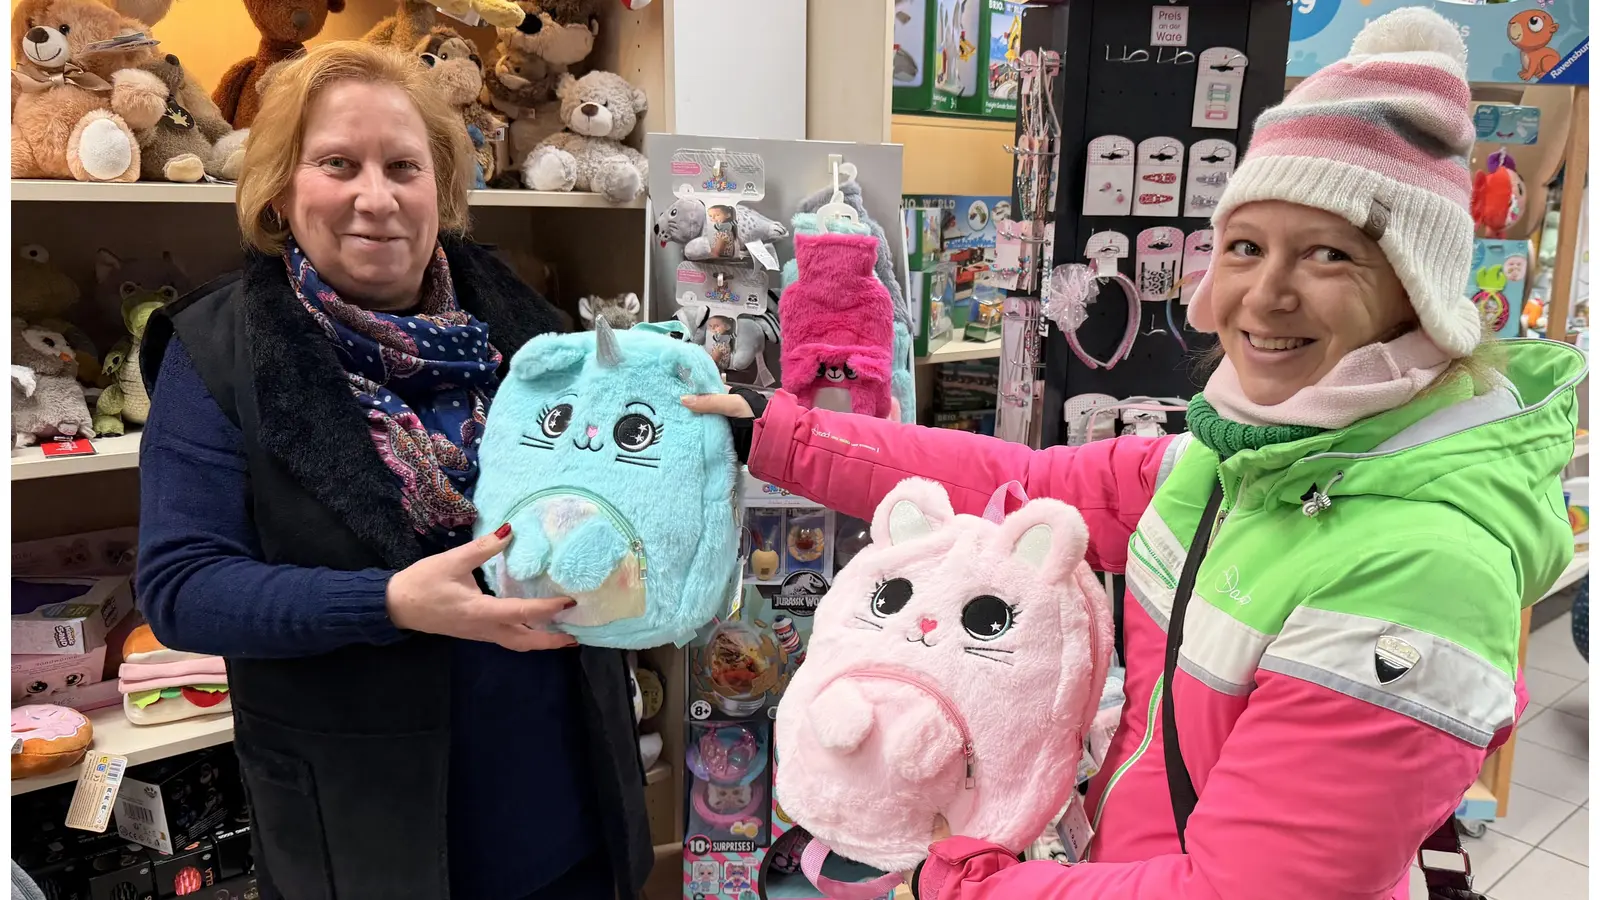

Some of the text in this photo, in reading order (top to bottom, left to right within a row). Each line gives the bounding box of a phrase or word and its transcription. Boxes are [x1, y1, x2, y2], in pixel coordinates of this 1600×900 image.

[1158, 10, 1182, 21] Preis
[1156, 31, 1182, 42] Ware
[774, 595, 804, 607] JURASSIC
[695, 705, 709, 716] 8+
[690, 839, 755, 853] 10+ SURPRISES!
